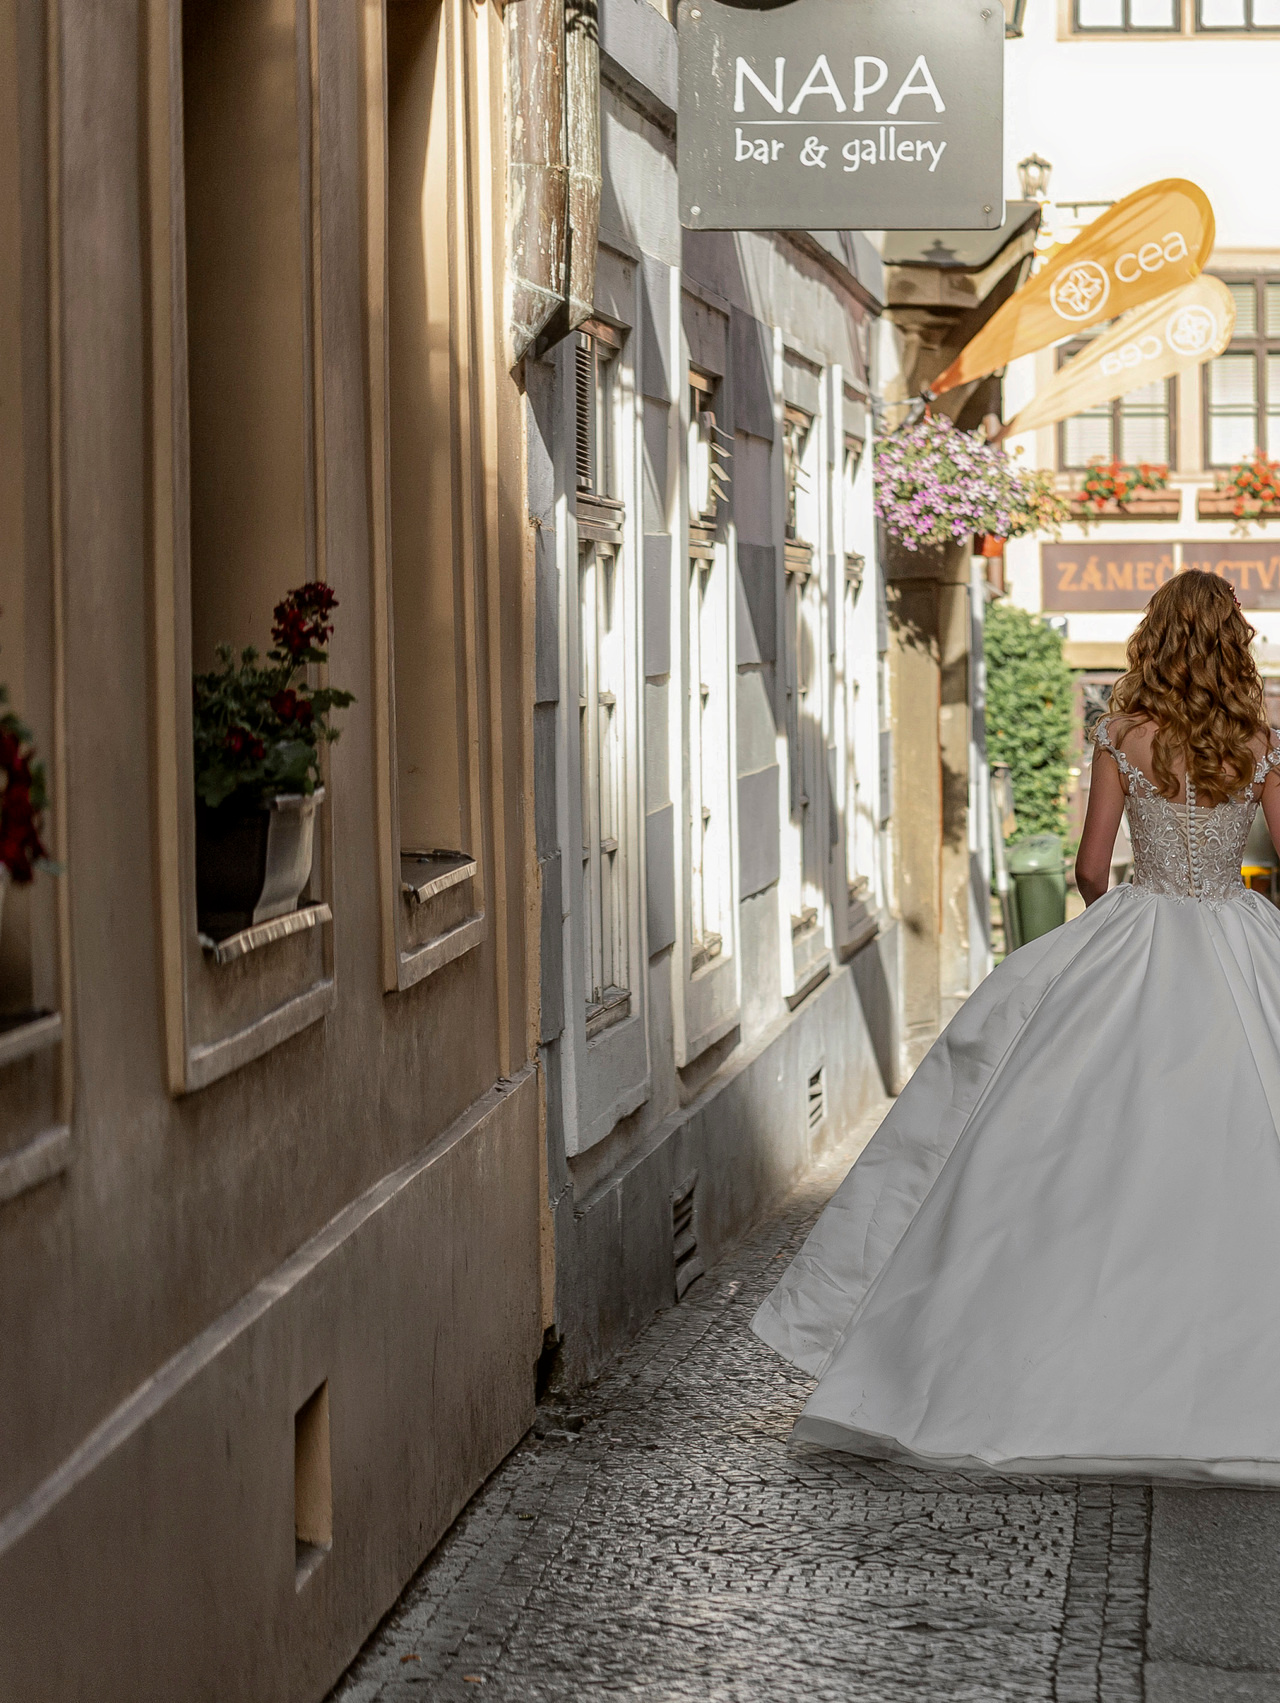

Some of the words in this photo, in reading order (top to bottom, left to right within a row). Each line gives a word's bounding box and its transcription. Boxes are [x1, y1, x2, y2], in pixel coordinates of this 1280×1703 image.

[733, 54, 946, 115] NAPA
[734, 127, 785, 164] bar
[800, 136, 829, 169] &
[842, 126, 947, 172] gallery
[1114, 231, 1188, 283] cea
